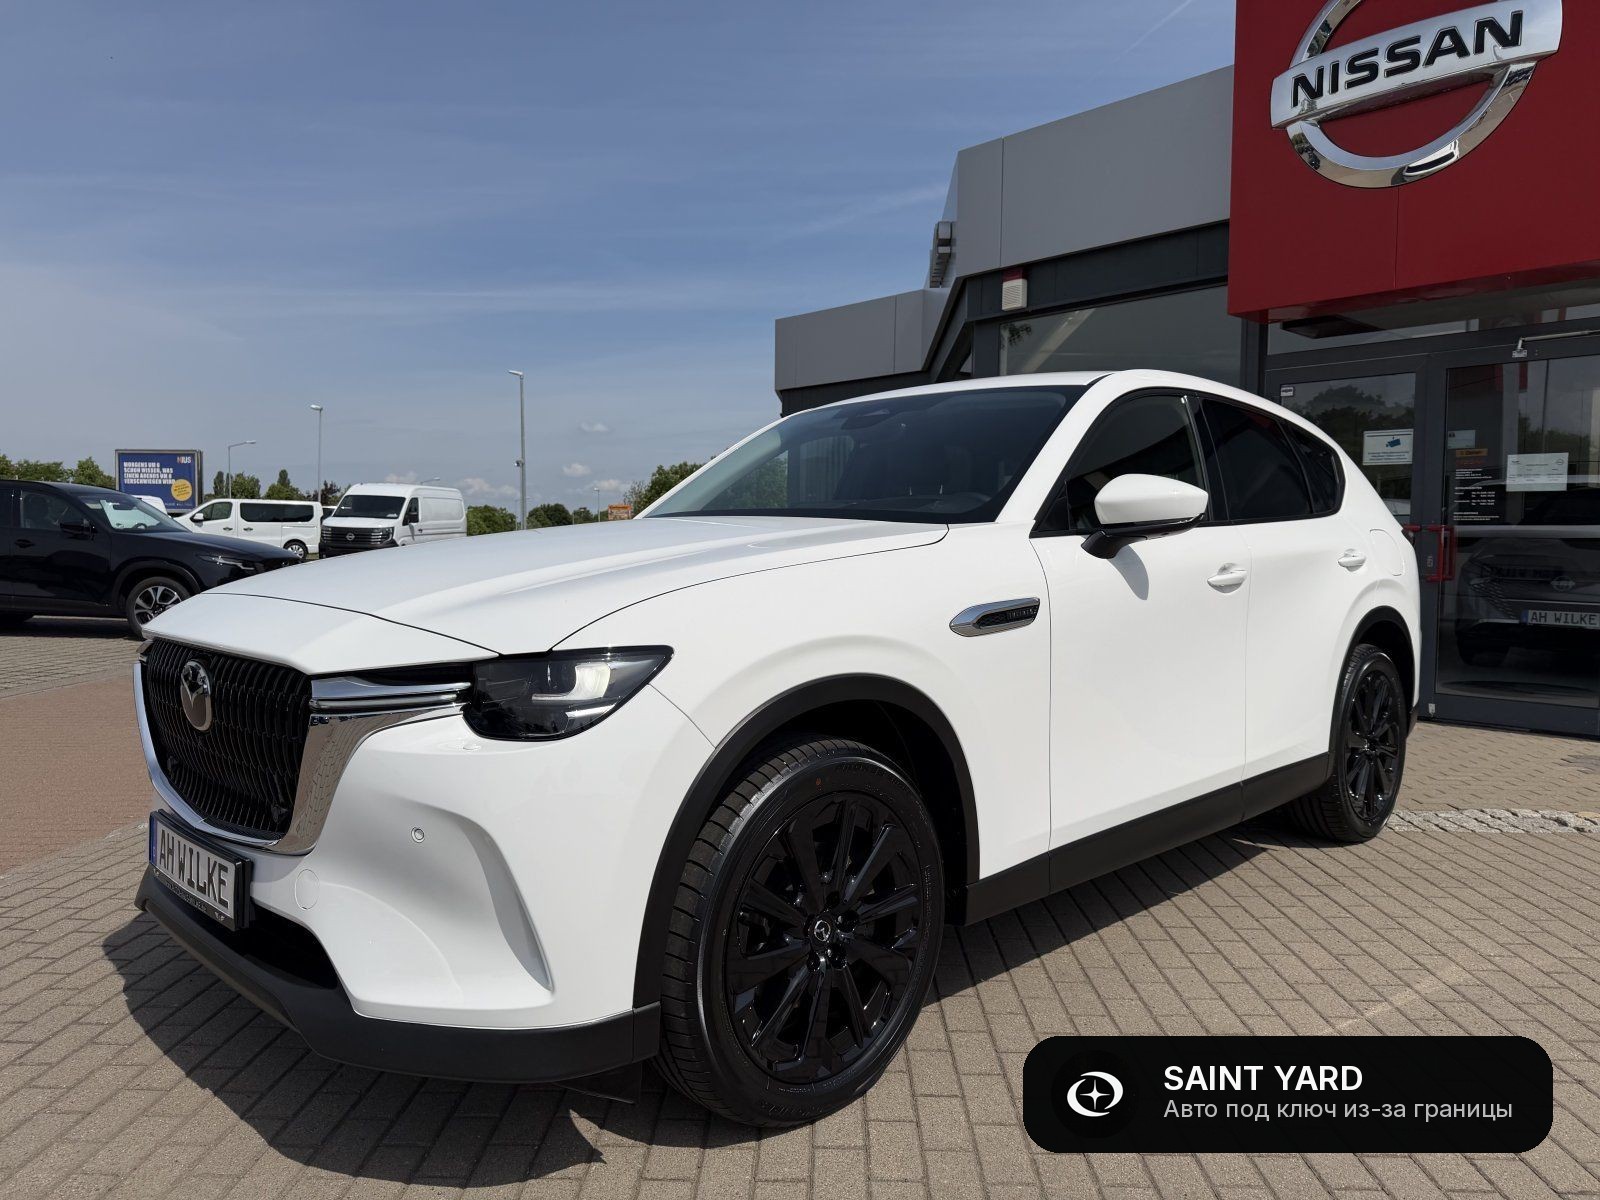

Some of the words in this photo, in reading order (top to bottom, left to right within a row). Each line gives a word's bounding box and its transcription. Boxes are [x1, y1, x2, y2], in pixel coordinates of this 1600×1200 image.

[1291, 10, 1523, 109] NISSAN
[1530, 611, 1548, 623] AH
[1554, 612, 1598, 626] WILKE
[159, 829, 175, 874] AH
[178, 840, 230, 909] WILKE
